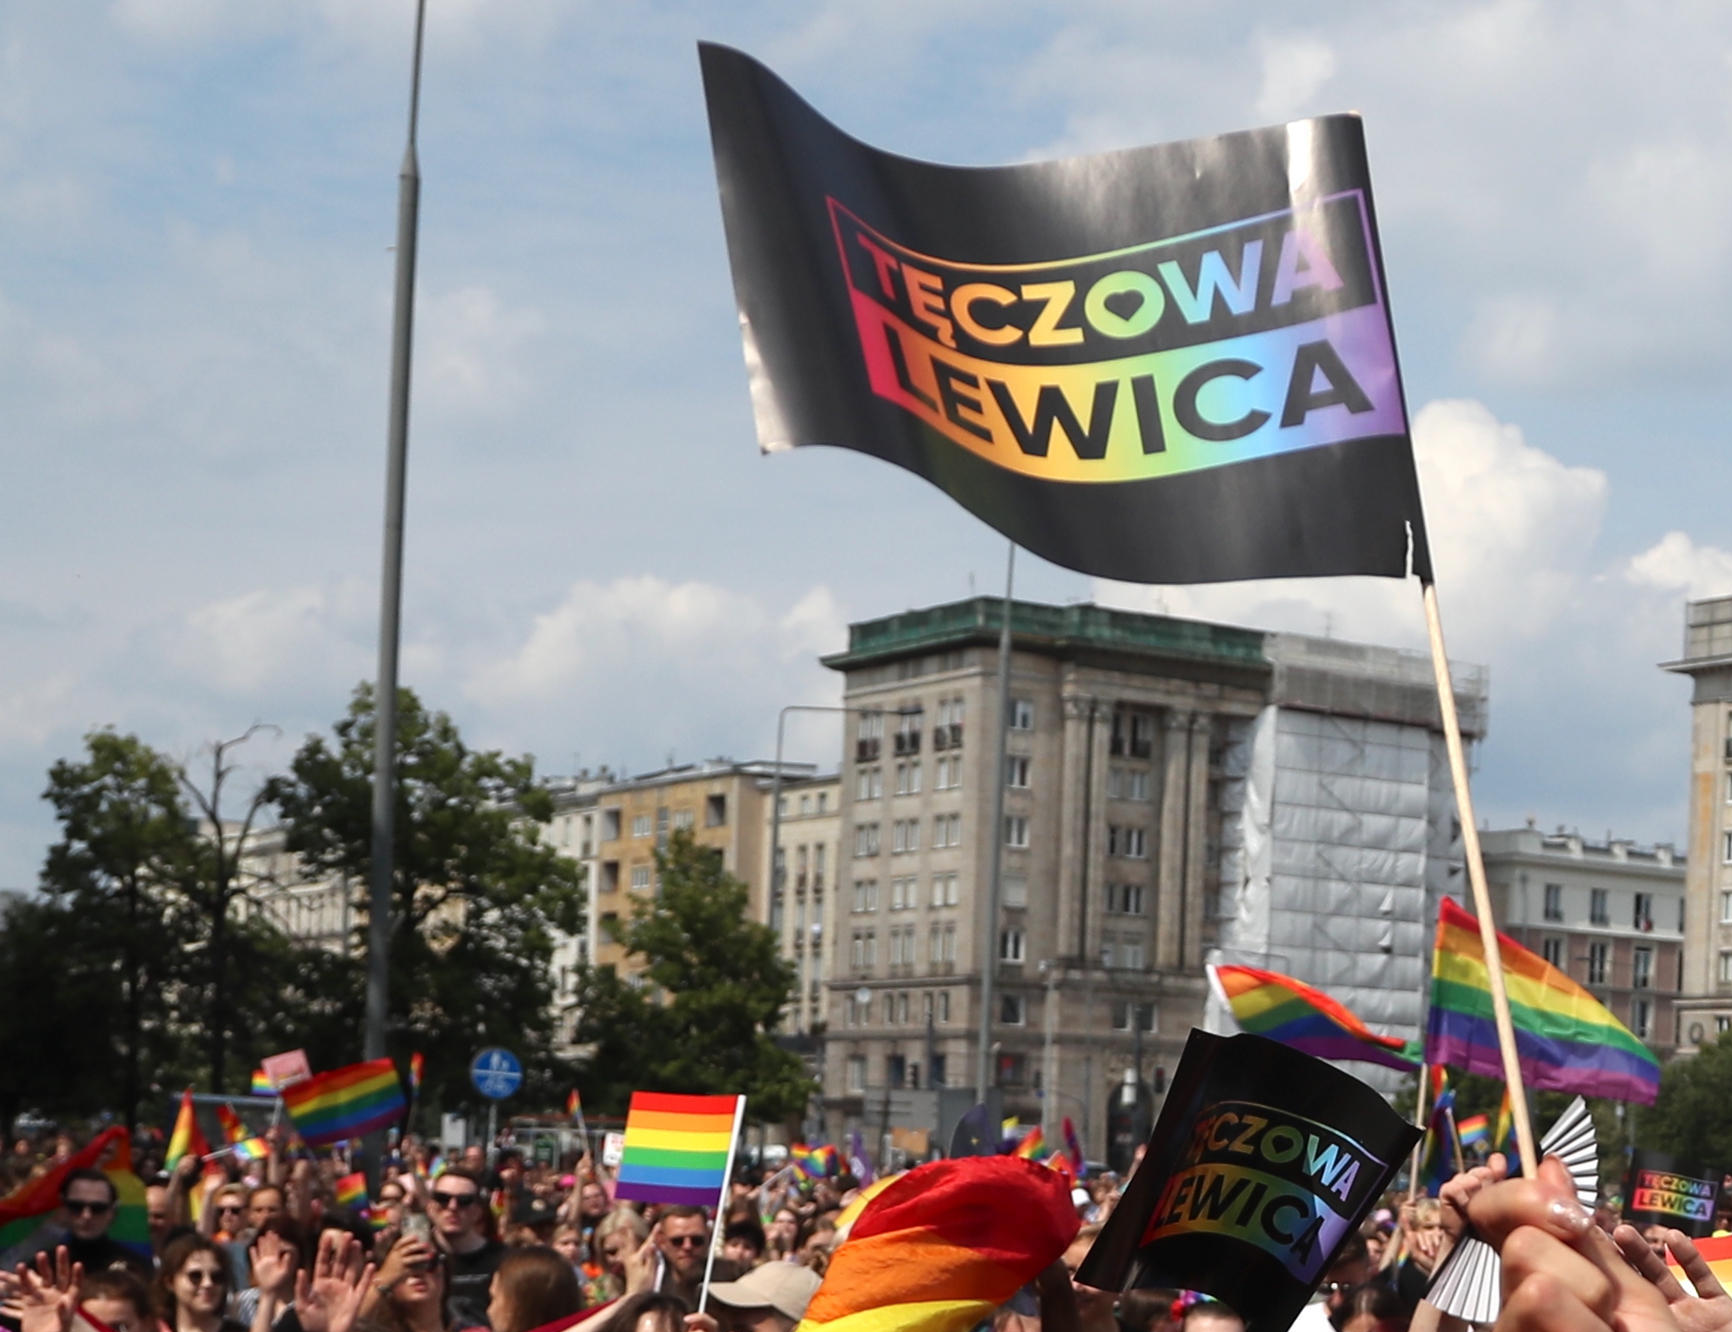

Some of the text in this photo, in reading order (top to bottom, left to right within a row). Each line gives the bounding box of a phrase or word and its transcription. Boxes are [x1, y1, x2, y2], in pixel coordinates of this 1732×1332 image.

[857, 229, 1345, 349] TĘCZOWA
[883, 322, 1376, 460] LEWICA
[1638, 1191, 1707, 1217] LEWICA
